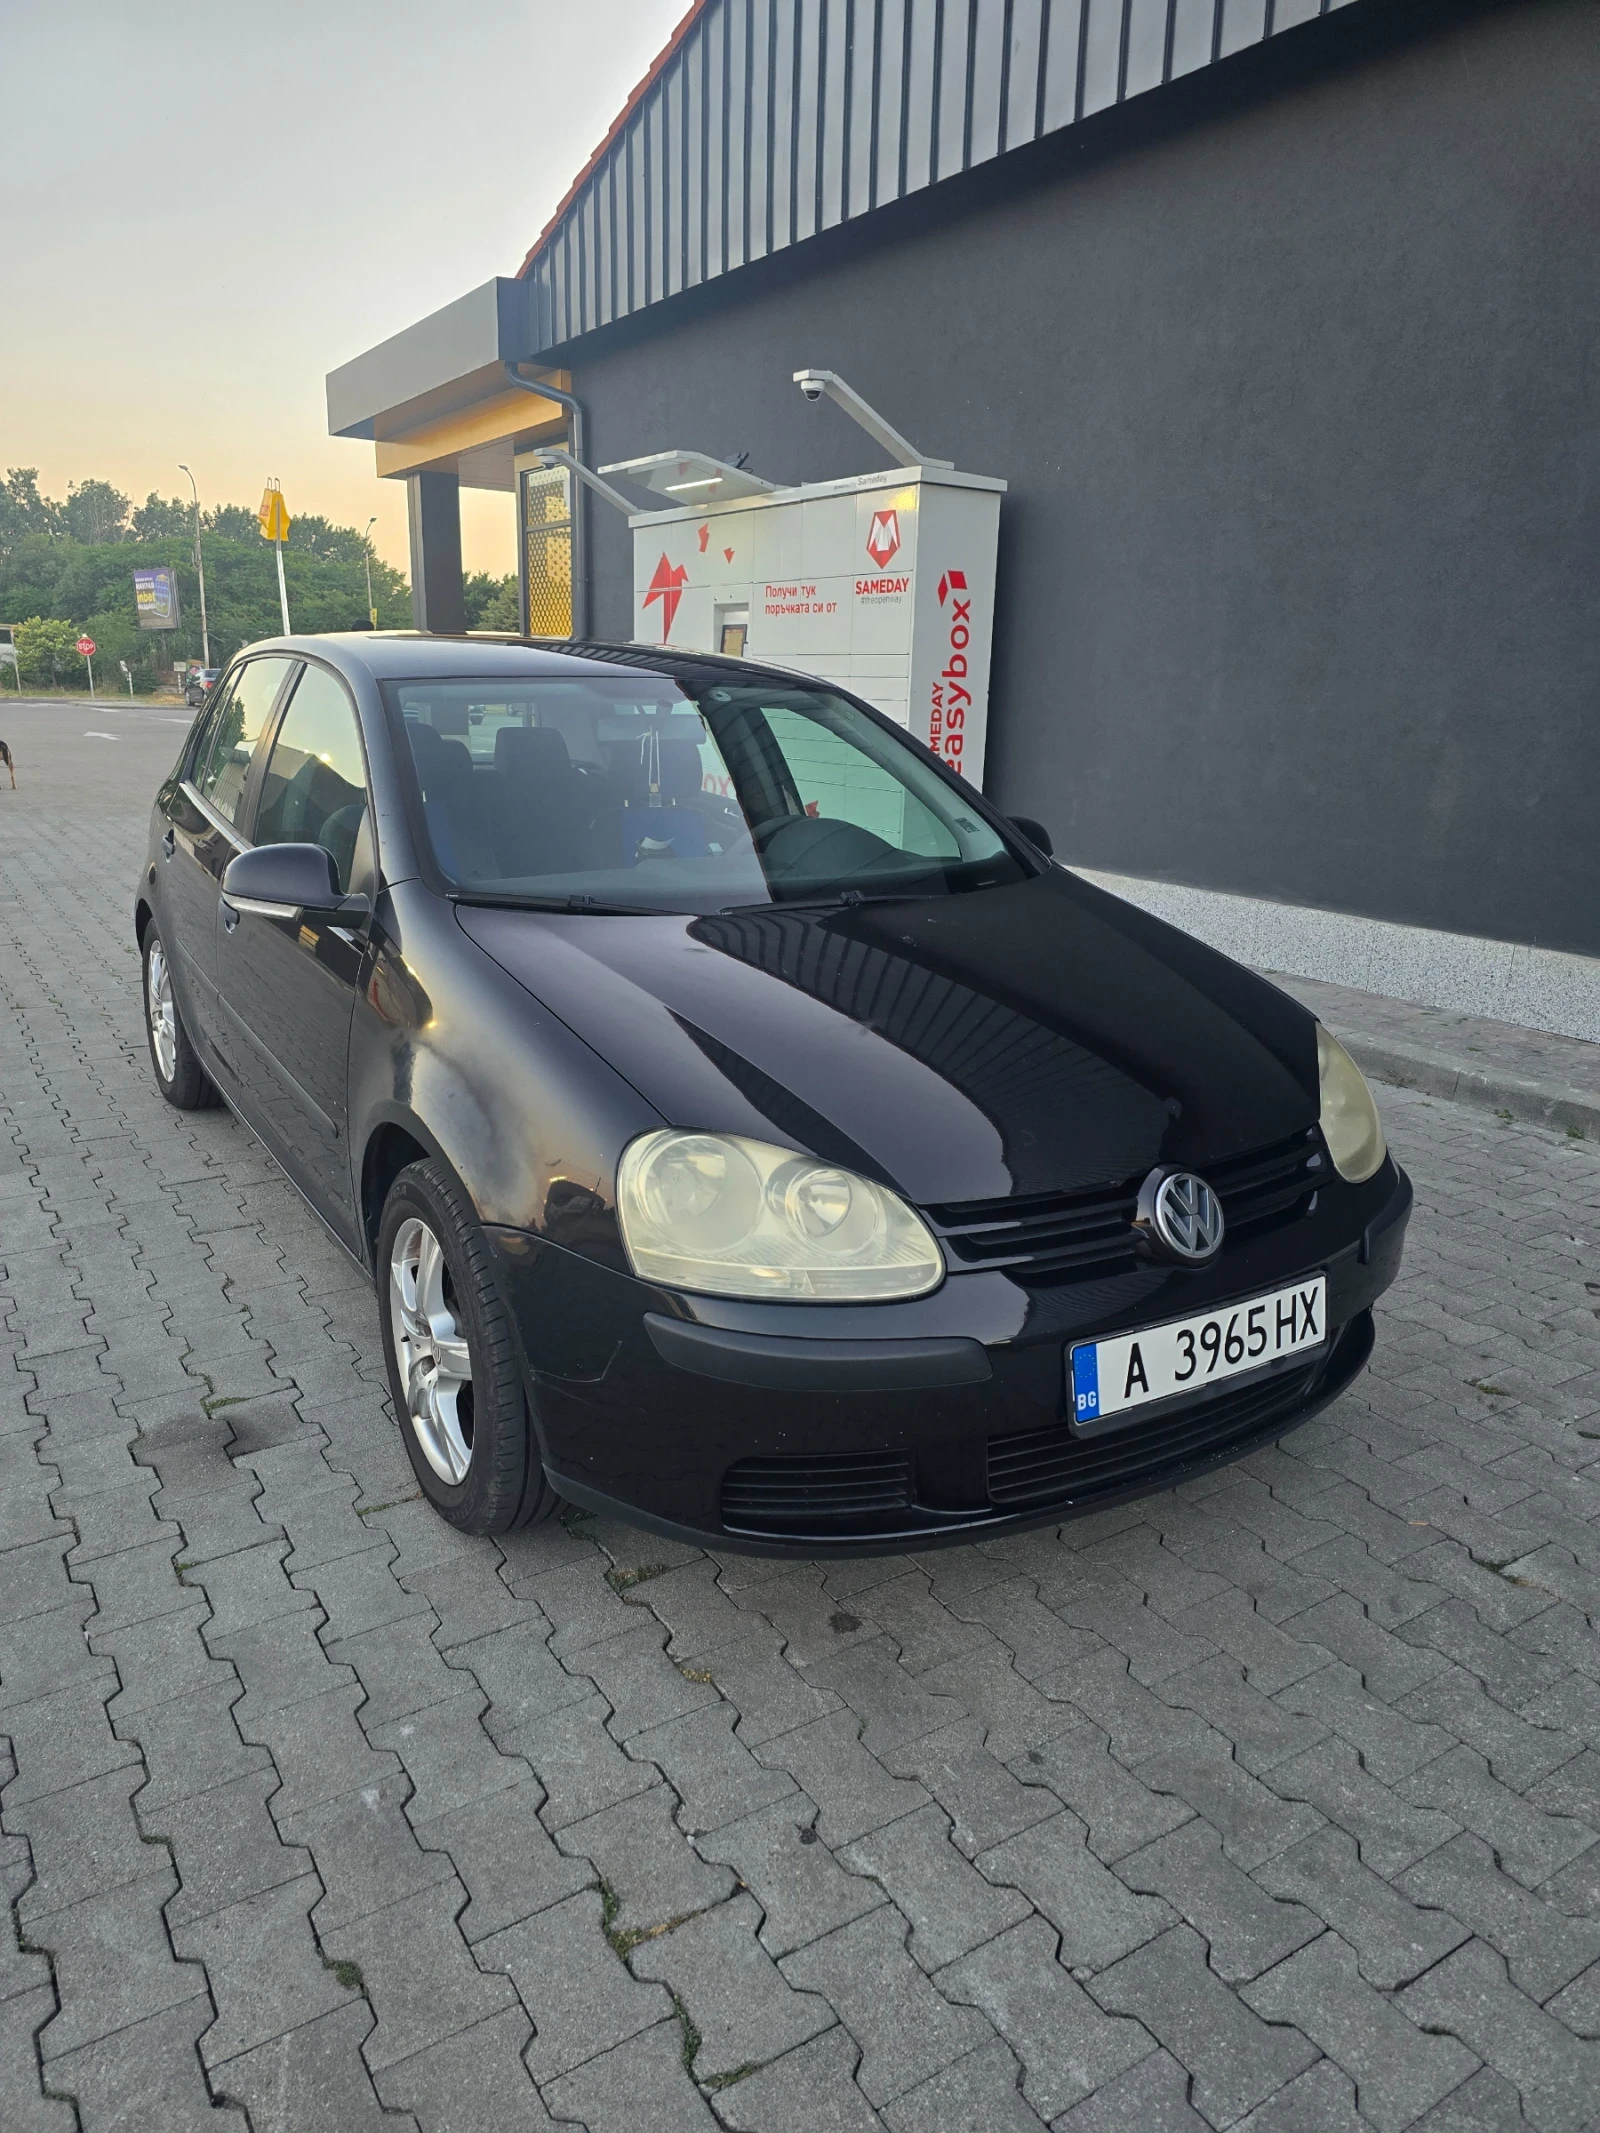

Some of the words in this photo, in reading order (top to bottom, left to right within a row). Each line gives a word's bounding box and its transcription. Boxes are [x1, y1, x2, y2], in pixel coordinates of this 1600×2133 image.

[858, 474, 888, 485] Sameday
[765, 585, 797, 600] Получи
[801, 585, 816, 598] тук
[855, 577, 910, 595] SAMEDAY
[765, 602, 809, 617] поръчката
[813, 602, 824, 613] си
[826, 602, 837, 613] от
[78, 643, 94, 651] STOP
[929, 681, 944, 757] MEDAY
[1123, 1342, 1150, 1399] A
[1076, 1390, 1098, 1412] BG
